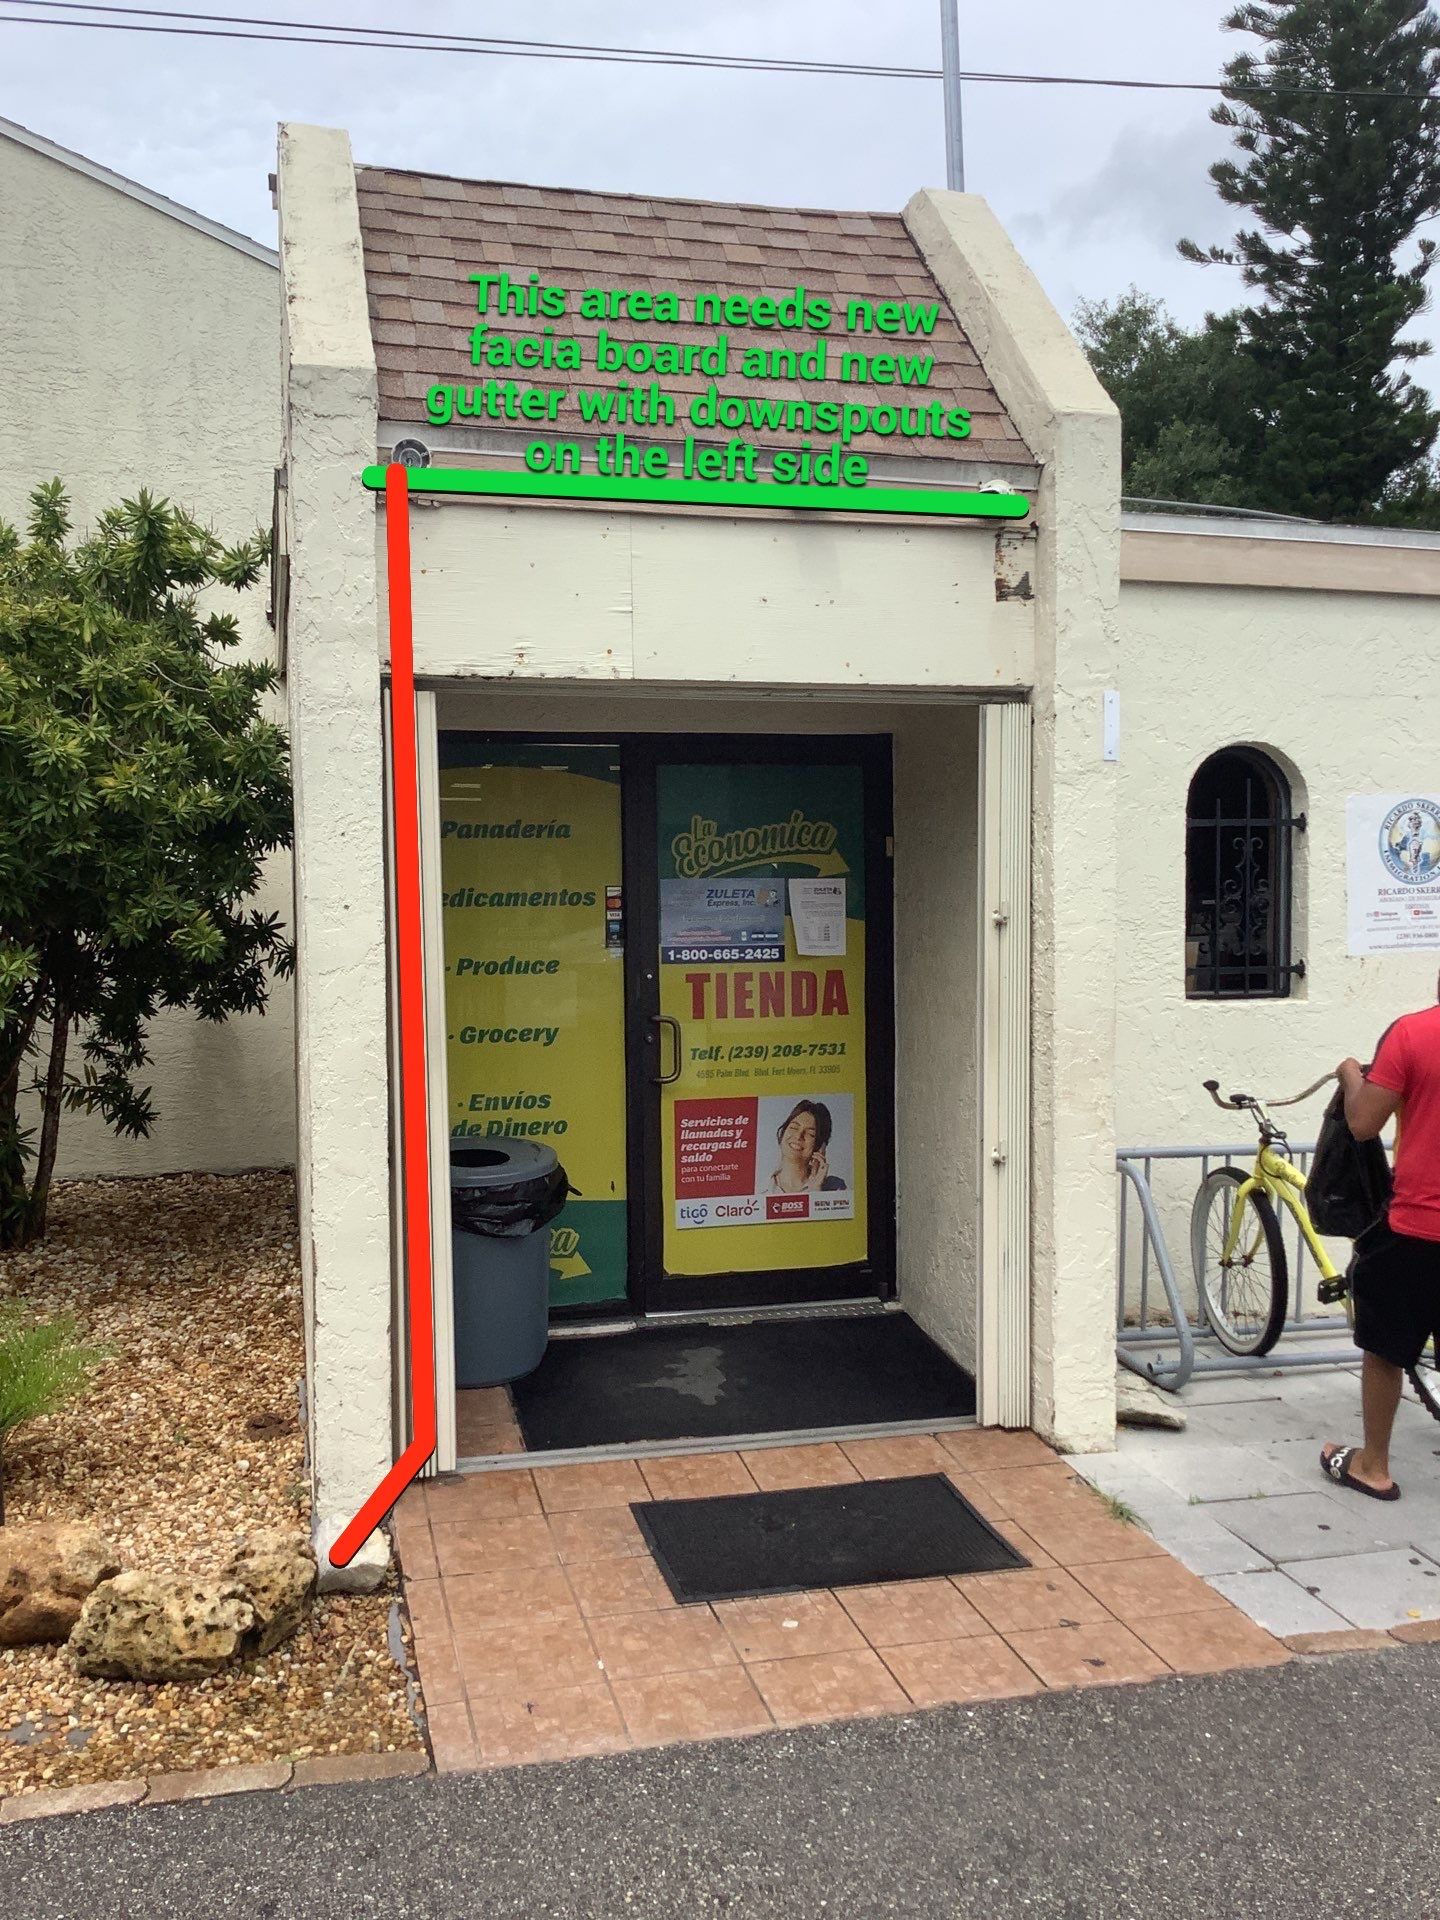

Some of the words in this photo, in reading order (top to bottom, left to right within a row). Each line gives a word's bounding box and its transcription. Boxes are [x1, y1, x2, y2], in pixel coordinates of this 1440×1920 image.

[1383, 802, 1413, 830] RICARDO
[441, 818, 572, 839] Panadería
[1383, 850, 1436, 881] IMMIGRATION
[706, 889, 756, 899] ZULETA
[1378, 887, 1415, 895] RICARDO
[668, 948, 780, 961] 1-800-665-2425
[456, 955, 560, 976] Produce
[685, 969, 850, 1020] TIENDA
[460, 1025, 560, 1047] Grocery
[690, 1046, 725, 1061] Telf.
[728, 1045, 769, 1062] (239)
[772, 1043, 846, 1058] 208-7531
[468, 1091, 552, 1111] Envíos
[451, 1119, 482, 1137] de
[486, 1117, 568, 1138] Dinero
[680, 1116, 734, 1128] Servicios
[735, 1115, 749, 1125] de
[680, 1128, 734, 1139] llamadas
[735, 1129, 743, 1139] y
[681, 1141, 733, 1152] recargas
[734, 1139, 748, 1149] de
[680, 1152, 713, 1163] saldo
[681, 1166, 698, 1175] para
[700, 1163, 739, 1172] conectarte
[706, 1173, 731, 1181] familia
[715, 1201, 756, 1218] Claro
